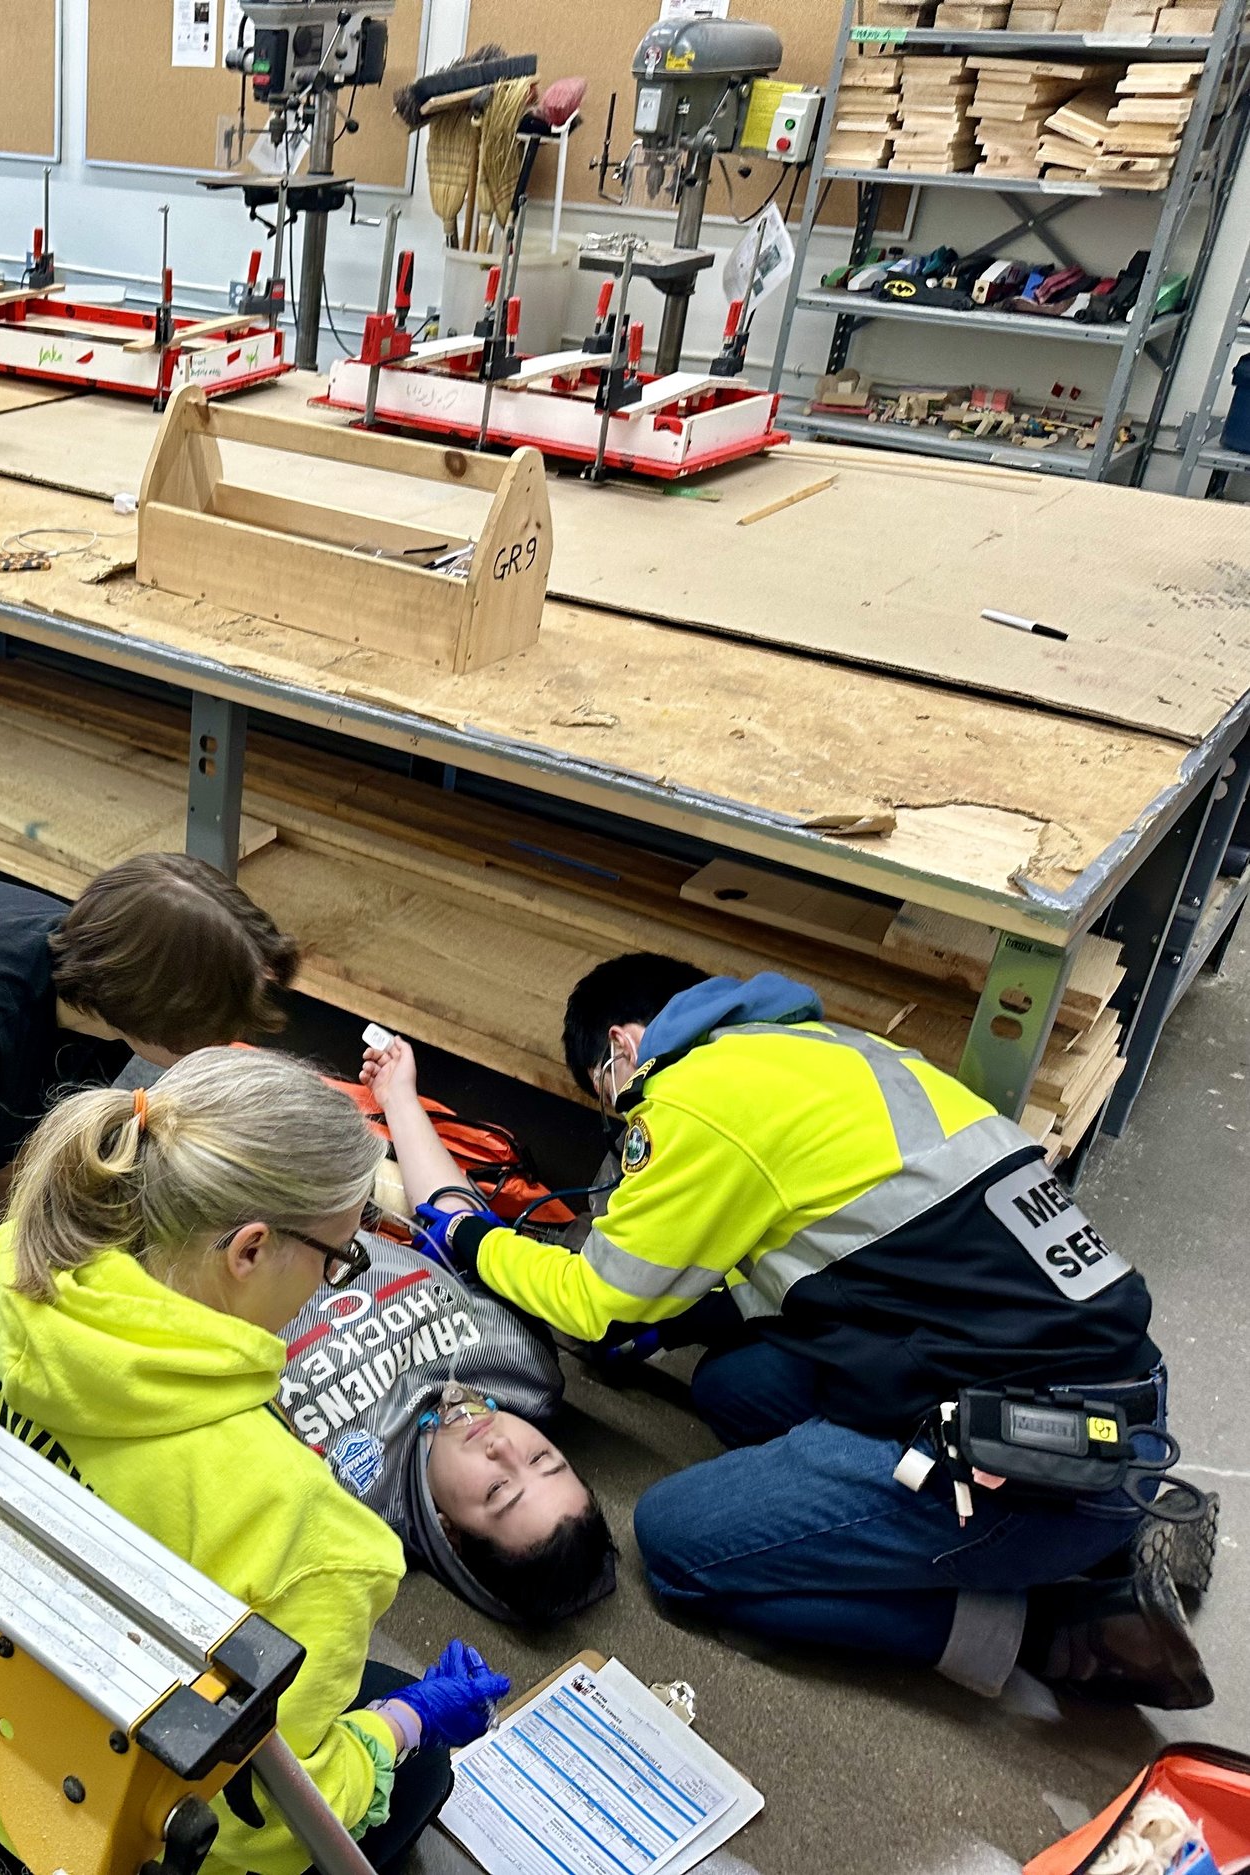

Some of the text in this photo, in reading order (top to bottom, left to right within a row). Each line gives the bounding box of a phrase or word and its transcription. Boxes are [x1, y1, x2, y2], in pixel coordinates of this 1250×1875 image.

[279, 1289, 438, 1409] HOCKEY
[294, 1311, 481, 1445] CANADIENS
[404, 1384, 433, 1415] Reebok
